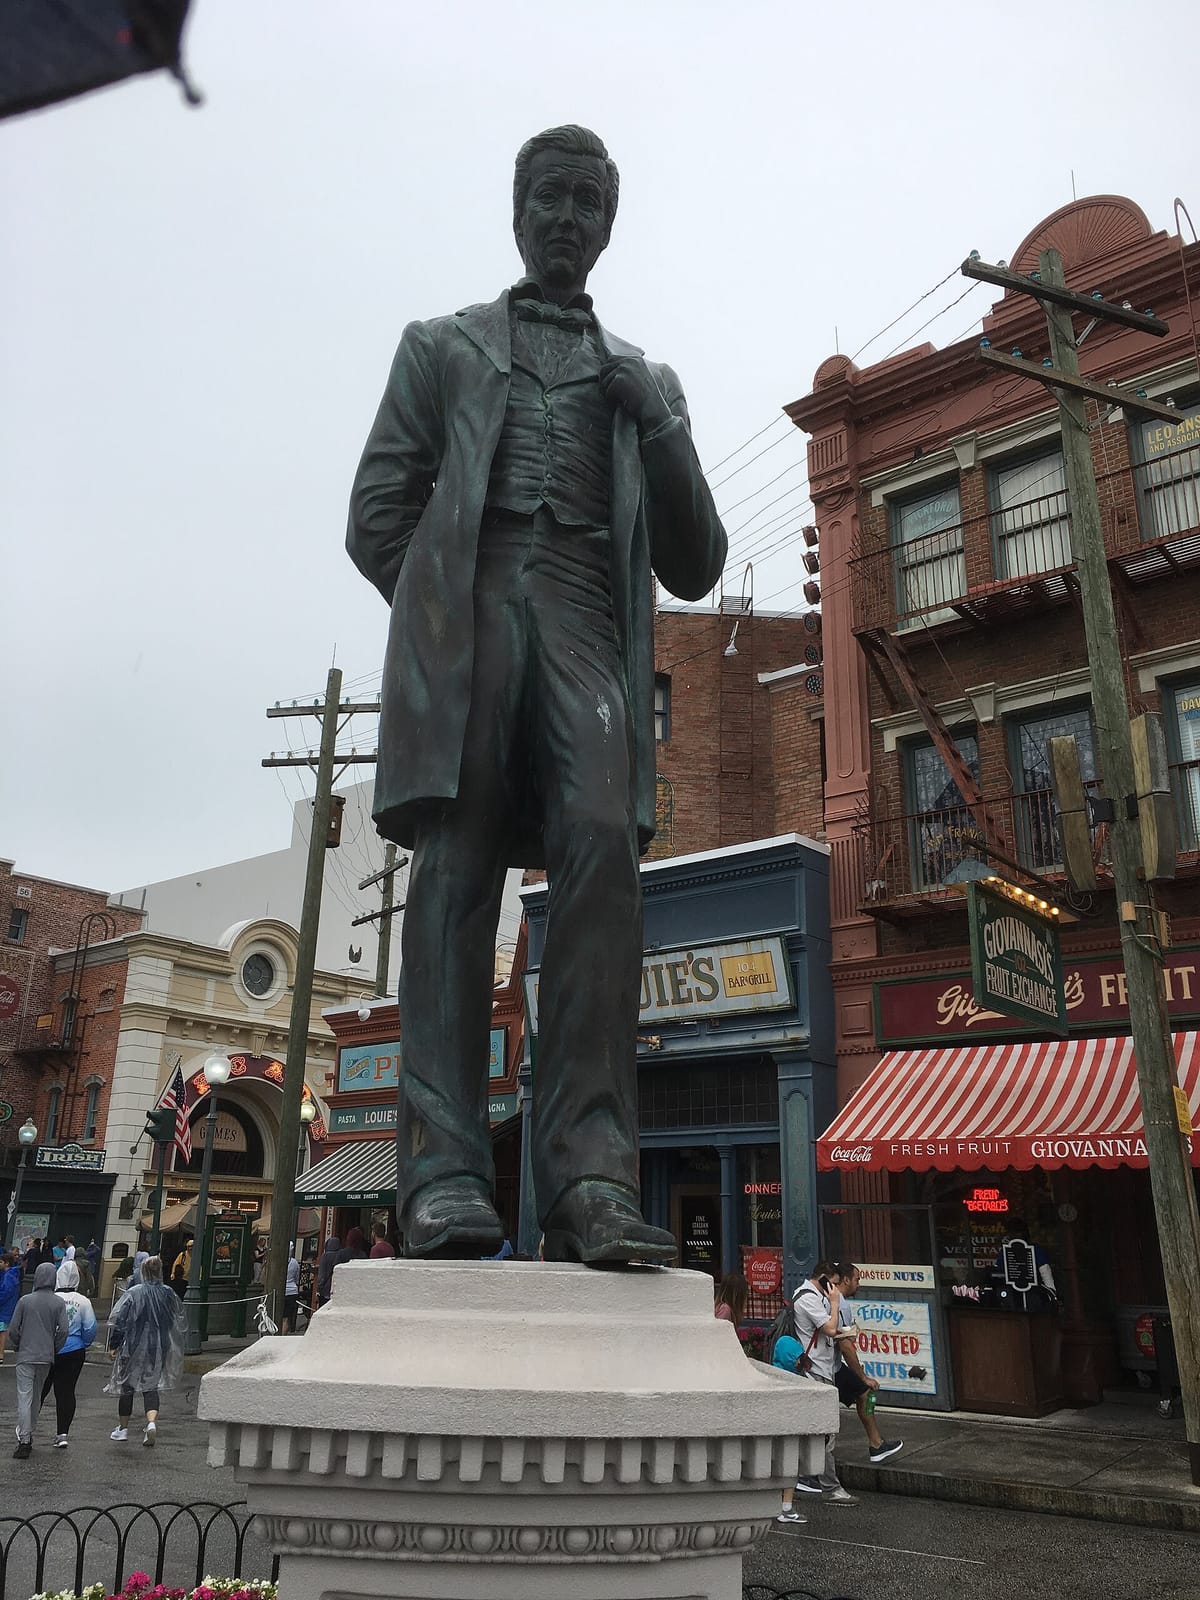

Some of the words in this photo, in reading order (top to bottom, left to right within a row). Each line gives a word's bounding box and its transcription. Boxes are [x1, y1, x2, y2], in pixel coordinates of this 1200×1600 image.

[1147, 425, 1172, 445] LEO
[1149, 442, 1165, 453] AND
[984, 916, 1054, 985] GIOVANNASI'S
[985, 961, 1010, 997] FRUIT
[1011, 971, 1057, 1014] EXCHANGE
[337, 1115, 356, 1125] PASTA
[200, 1126, 238, 1141] GMES
[890, 1143, 949, 1156] FRESH
[957, 1142, 1012, 1155] FRUIT
[40, 1151, 99, 1163] IRISH
[859, 1270, 891, 1281] OASTED
[893, 1271, 924, 1282] NUTS
[857, 1304, 904, 1326] Enjoy
[862, 1360, 908, 1380] NUTS
